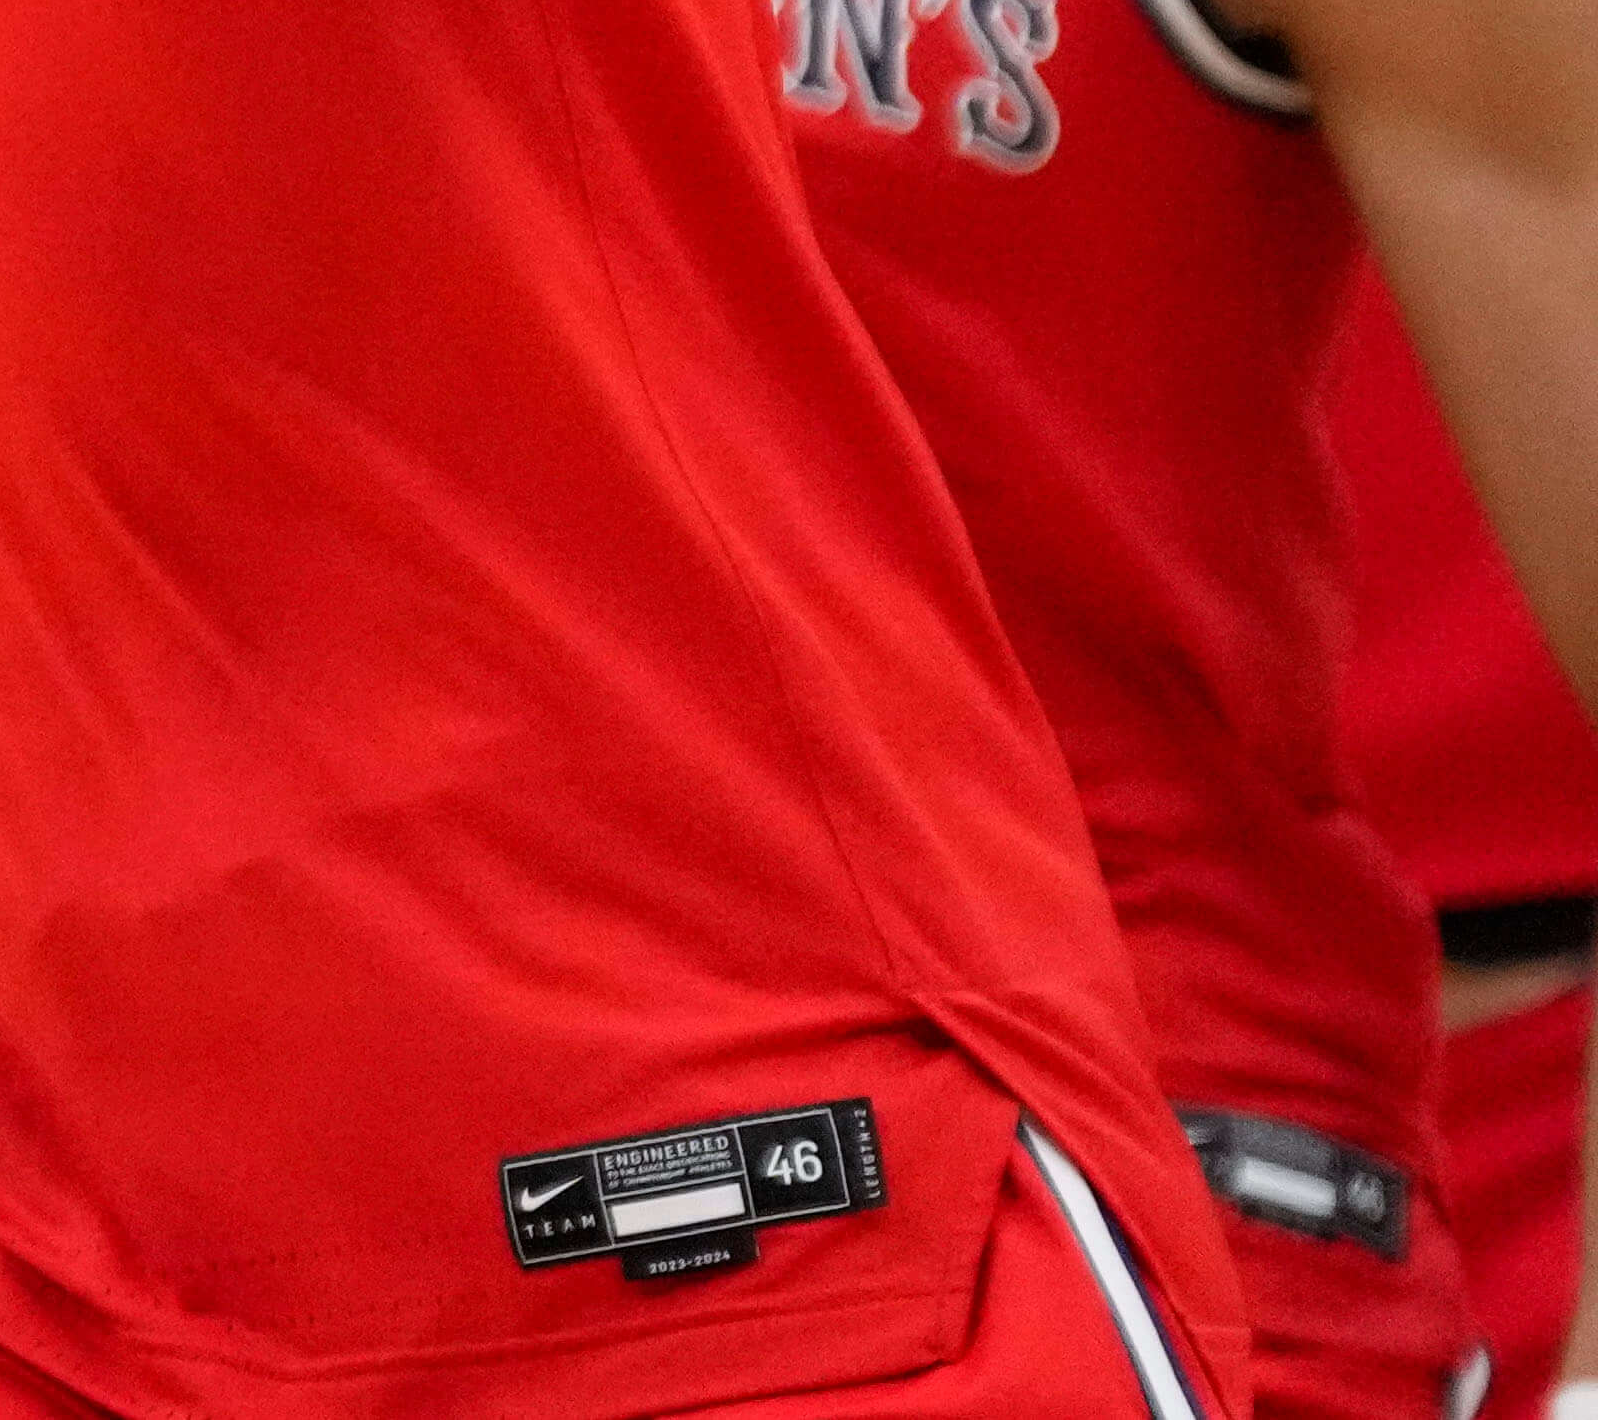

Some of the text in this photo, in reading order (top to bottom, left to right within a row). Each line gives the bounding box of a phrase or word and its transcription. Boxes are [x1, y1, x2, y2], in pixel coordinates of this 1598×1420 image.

[604, 1135, 730, 1171] ENGINEERED
[765, 1139, 825, 1187] 46
[525, 1212, 597, 1240] TEAM
